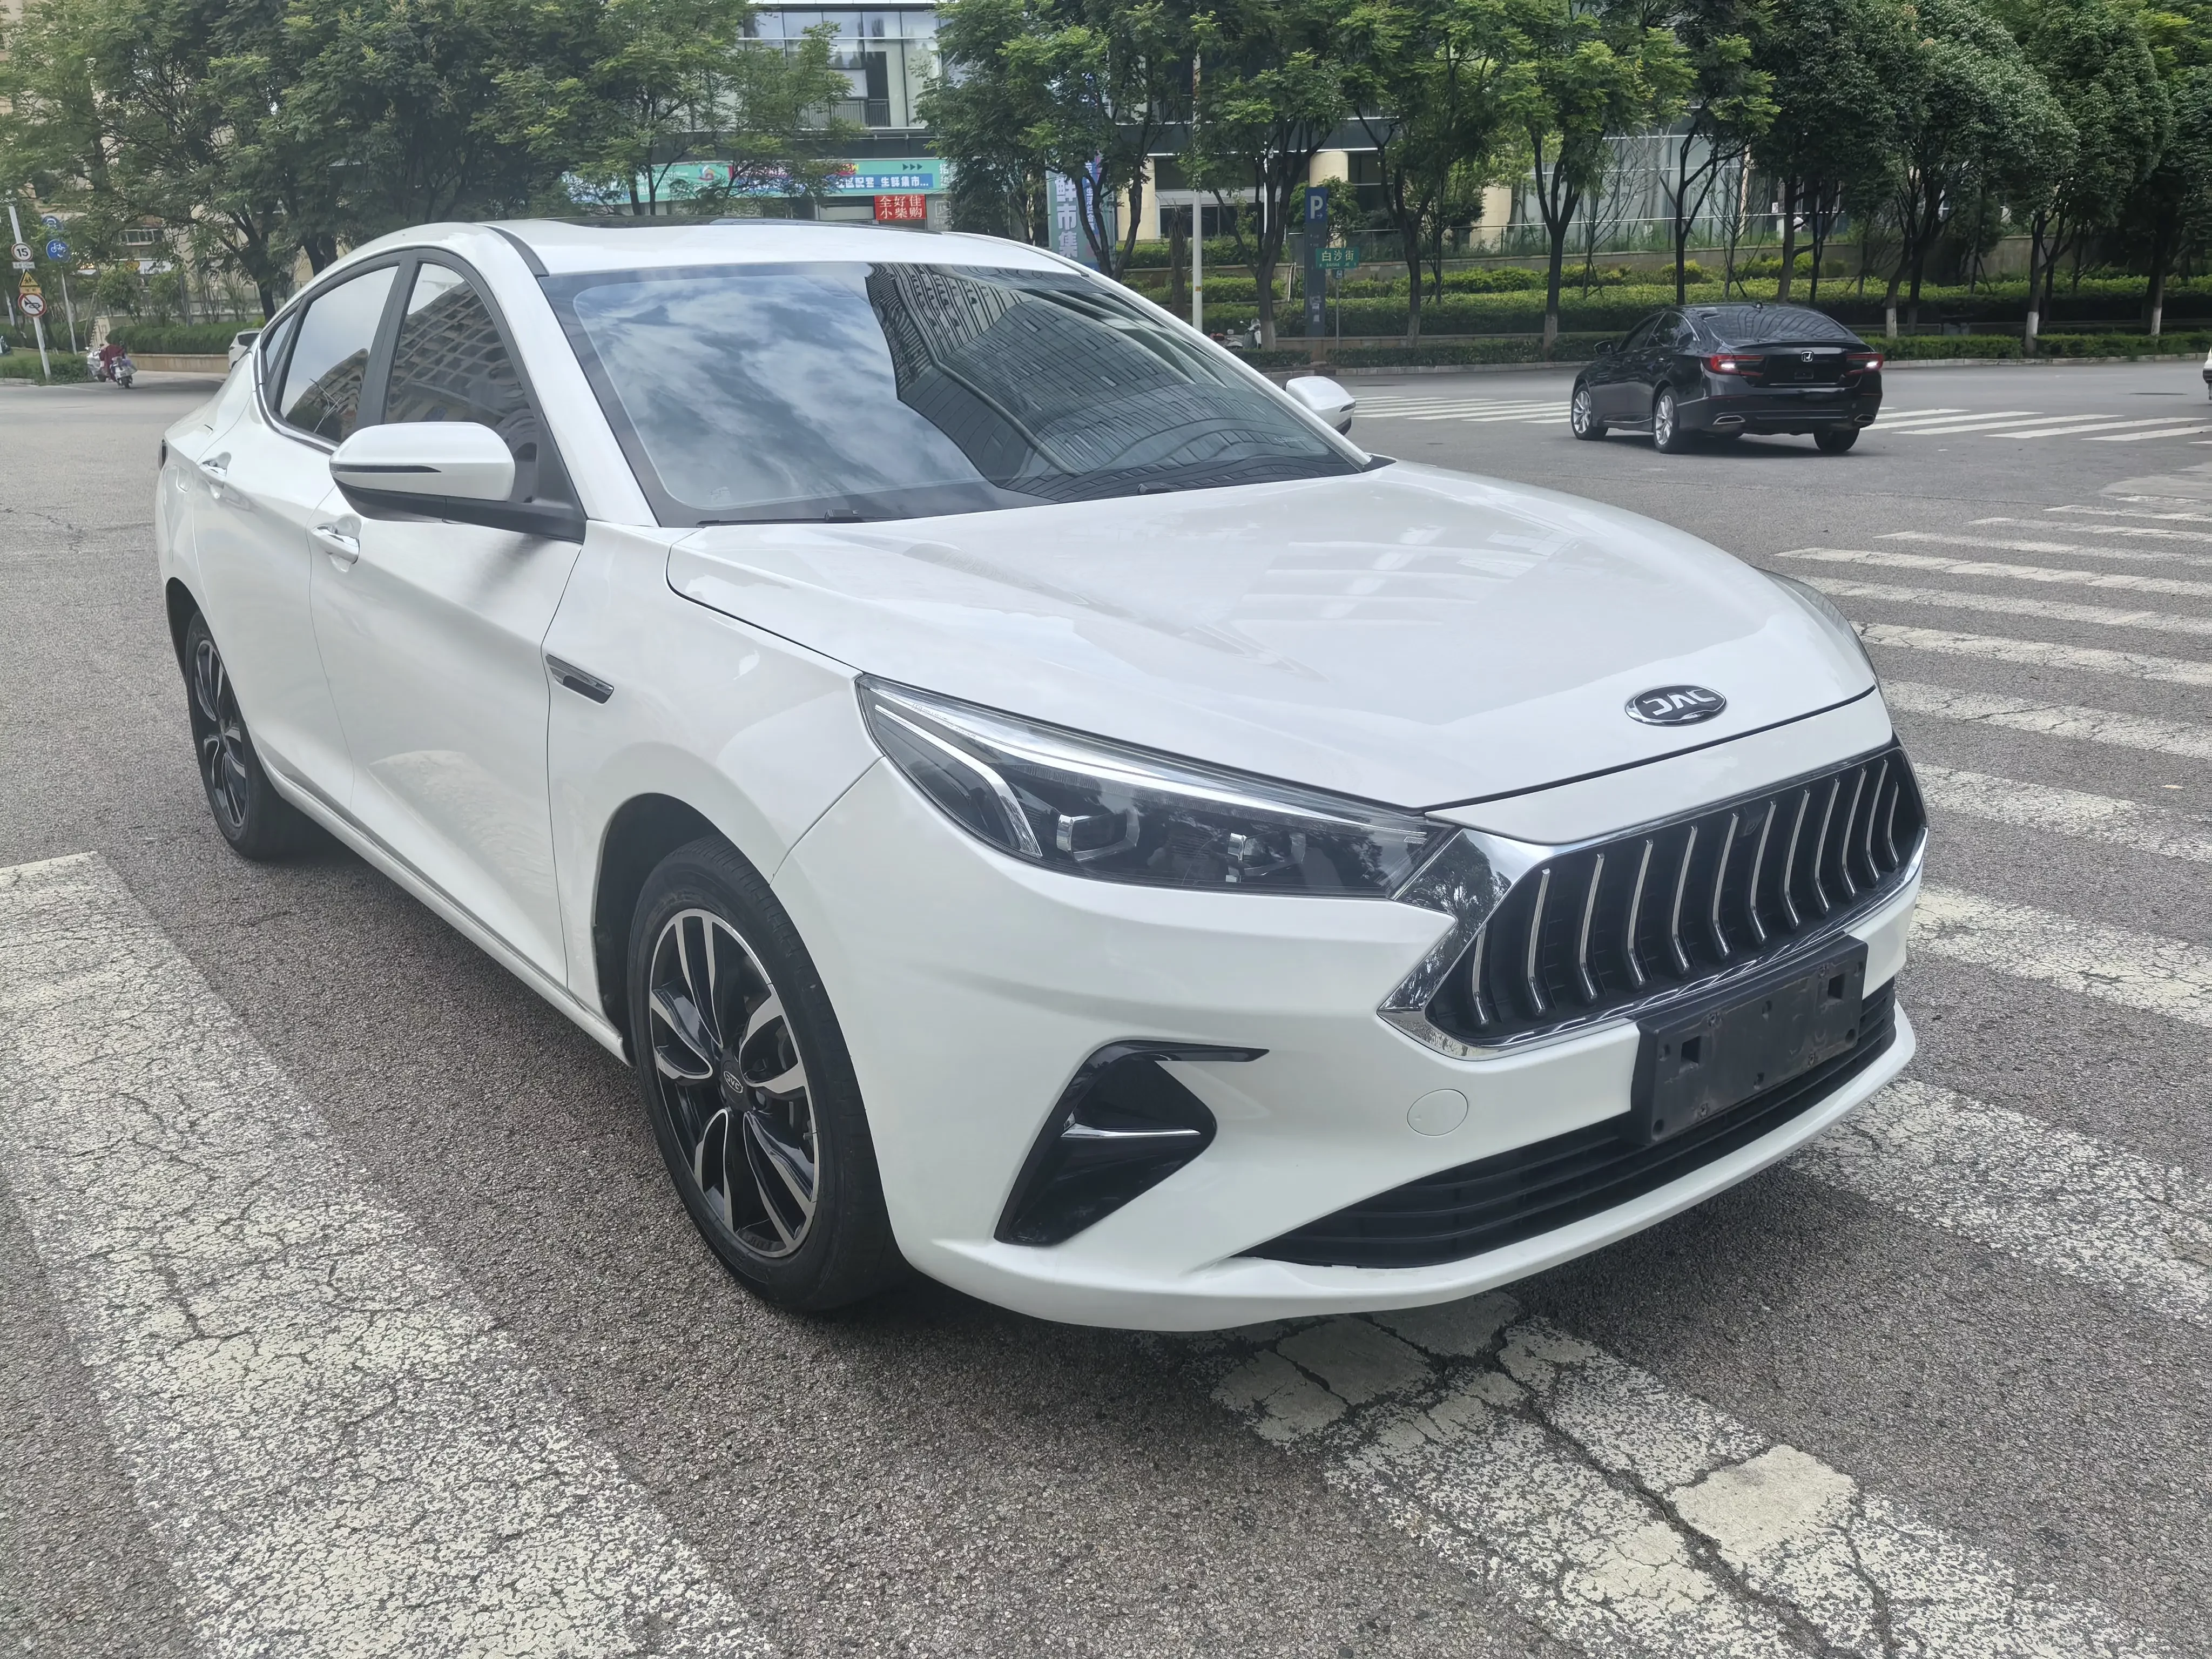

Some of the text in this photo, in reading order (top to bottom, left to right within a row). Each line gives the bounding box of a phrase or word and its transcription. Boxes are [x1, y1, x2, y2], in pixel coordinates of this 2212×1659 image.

[879, 195, 921, 207] 全好佳
[1310, 195, 1323, 219] P
[880, 207, 922, 219] 小柴购
[16, 248, 29, 257] 15
[1321, 250, 1354, 262] 白沙街
